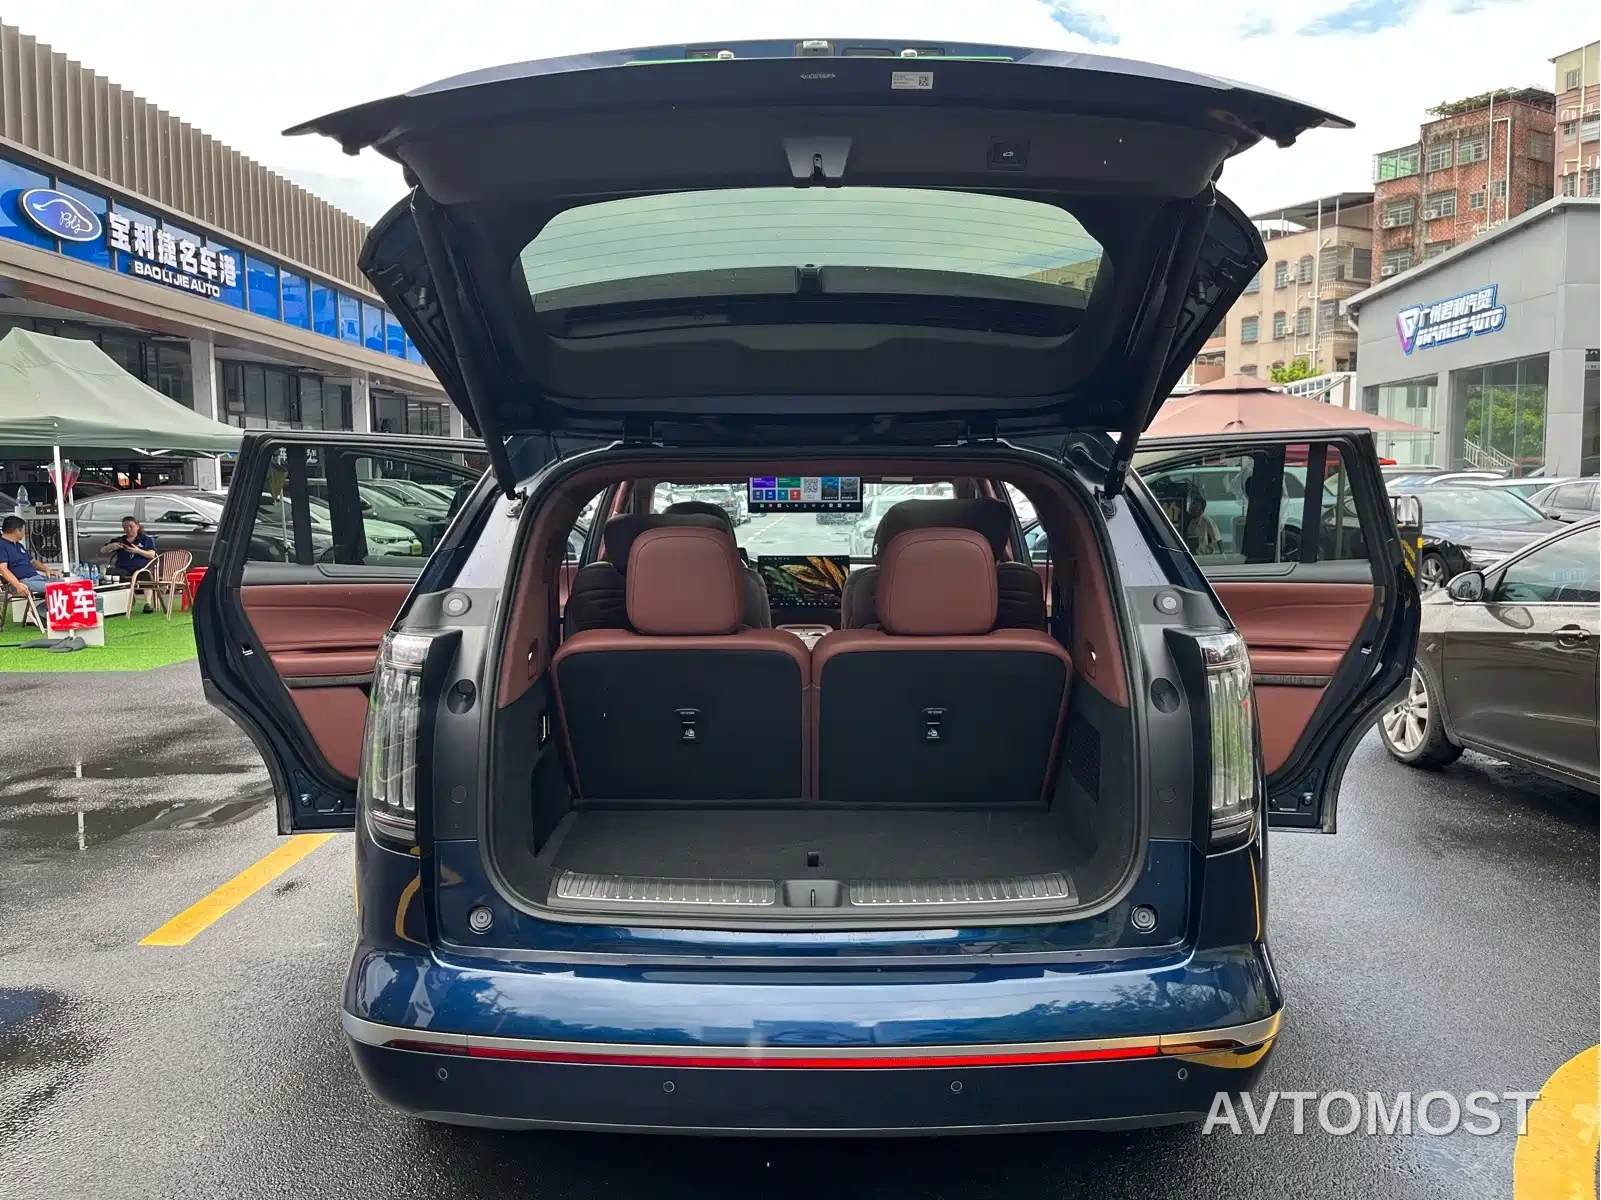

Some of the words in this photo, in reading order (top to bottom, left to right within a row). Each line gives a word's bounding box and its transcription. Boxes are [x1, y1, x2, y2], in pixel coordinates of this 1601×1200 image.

[108, 211, 236, 288] 宝利捷名车港
[190, 279, 220, 298] AUTO
[48, 587, 96, 620] 收车
